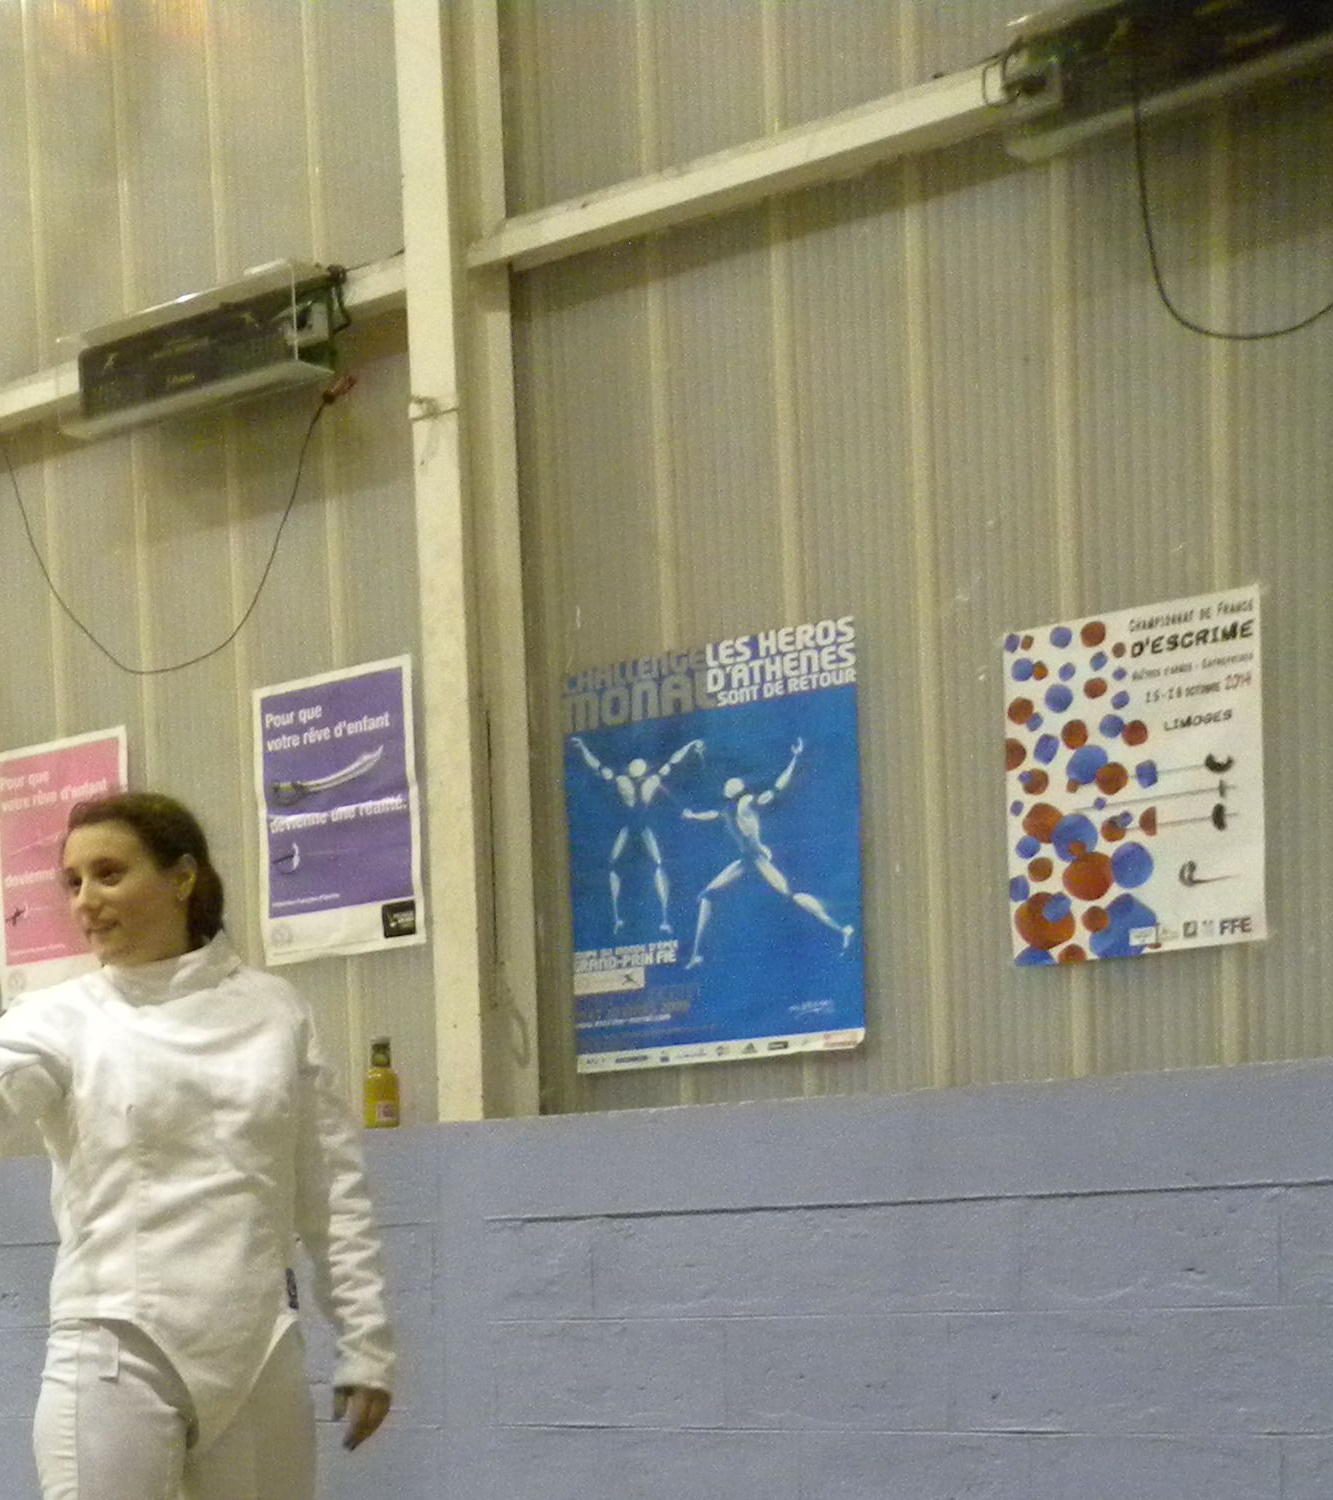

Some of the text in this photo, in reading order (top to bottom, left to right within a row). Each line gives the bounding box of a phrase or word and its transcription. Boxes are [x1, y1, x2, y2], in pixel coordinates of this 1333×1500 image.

[706, 616, 855, 667] LES HEROS
[1131, 618, 1255, 658] D'ESCRIME
[706, 642, 856, 693] D'ATHENES
[717, 668, 857, 706] SONT DE RETOUR
[265, 704, 323, 728] Pour que
[267, 711, 390, 752] votre rêve d'enfant
[1164, 709, 1233, 731] LIMOGES
[269, 812, 327, 834] devienne
[331, 804, 356, 822] une
[1219, 916, 1252, 935] FFE
